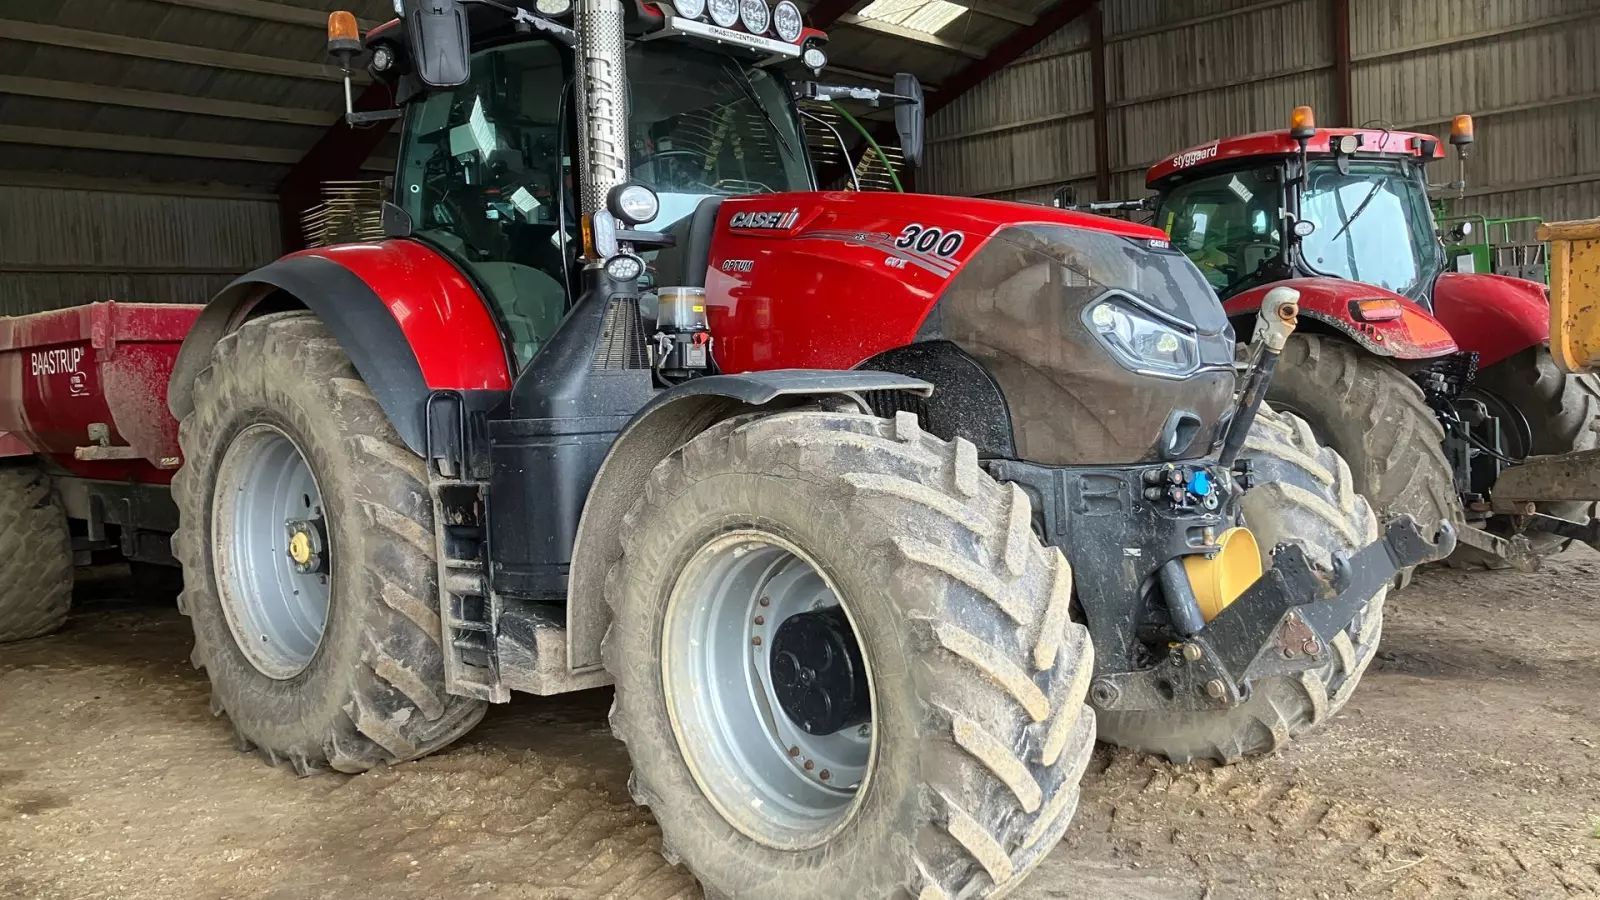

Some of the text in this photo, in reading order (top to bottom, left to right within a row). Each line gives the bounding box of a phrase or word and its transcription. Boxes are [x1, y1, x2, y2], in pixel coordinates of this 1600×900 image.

[1173, 144, 1218, 168] styggaard
[894, 223, 965, 259] 300
[721, 259, 755, 272] OPTUM
[31, 347, 81, 376] BAASTRUP
